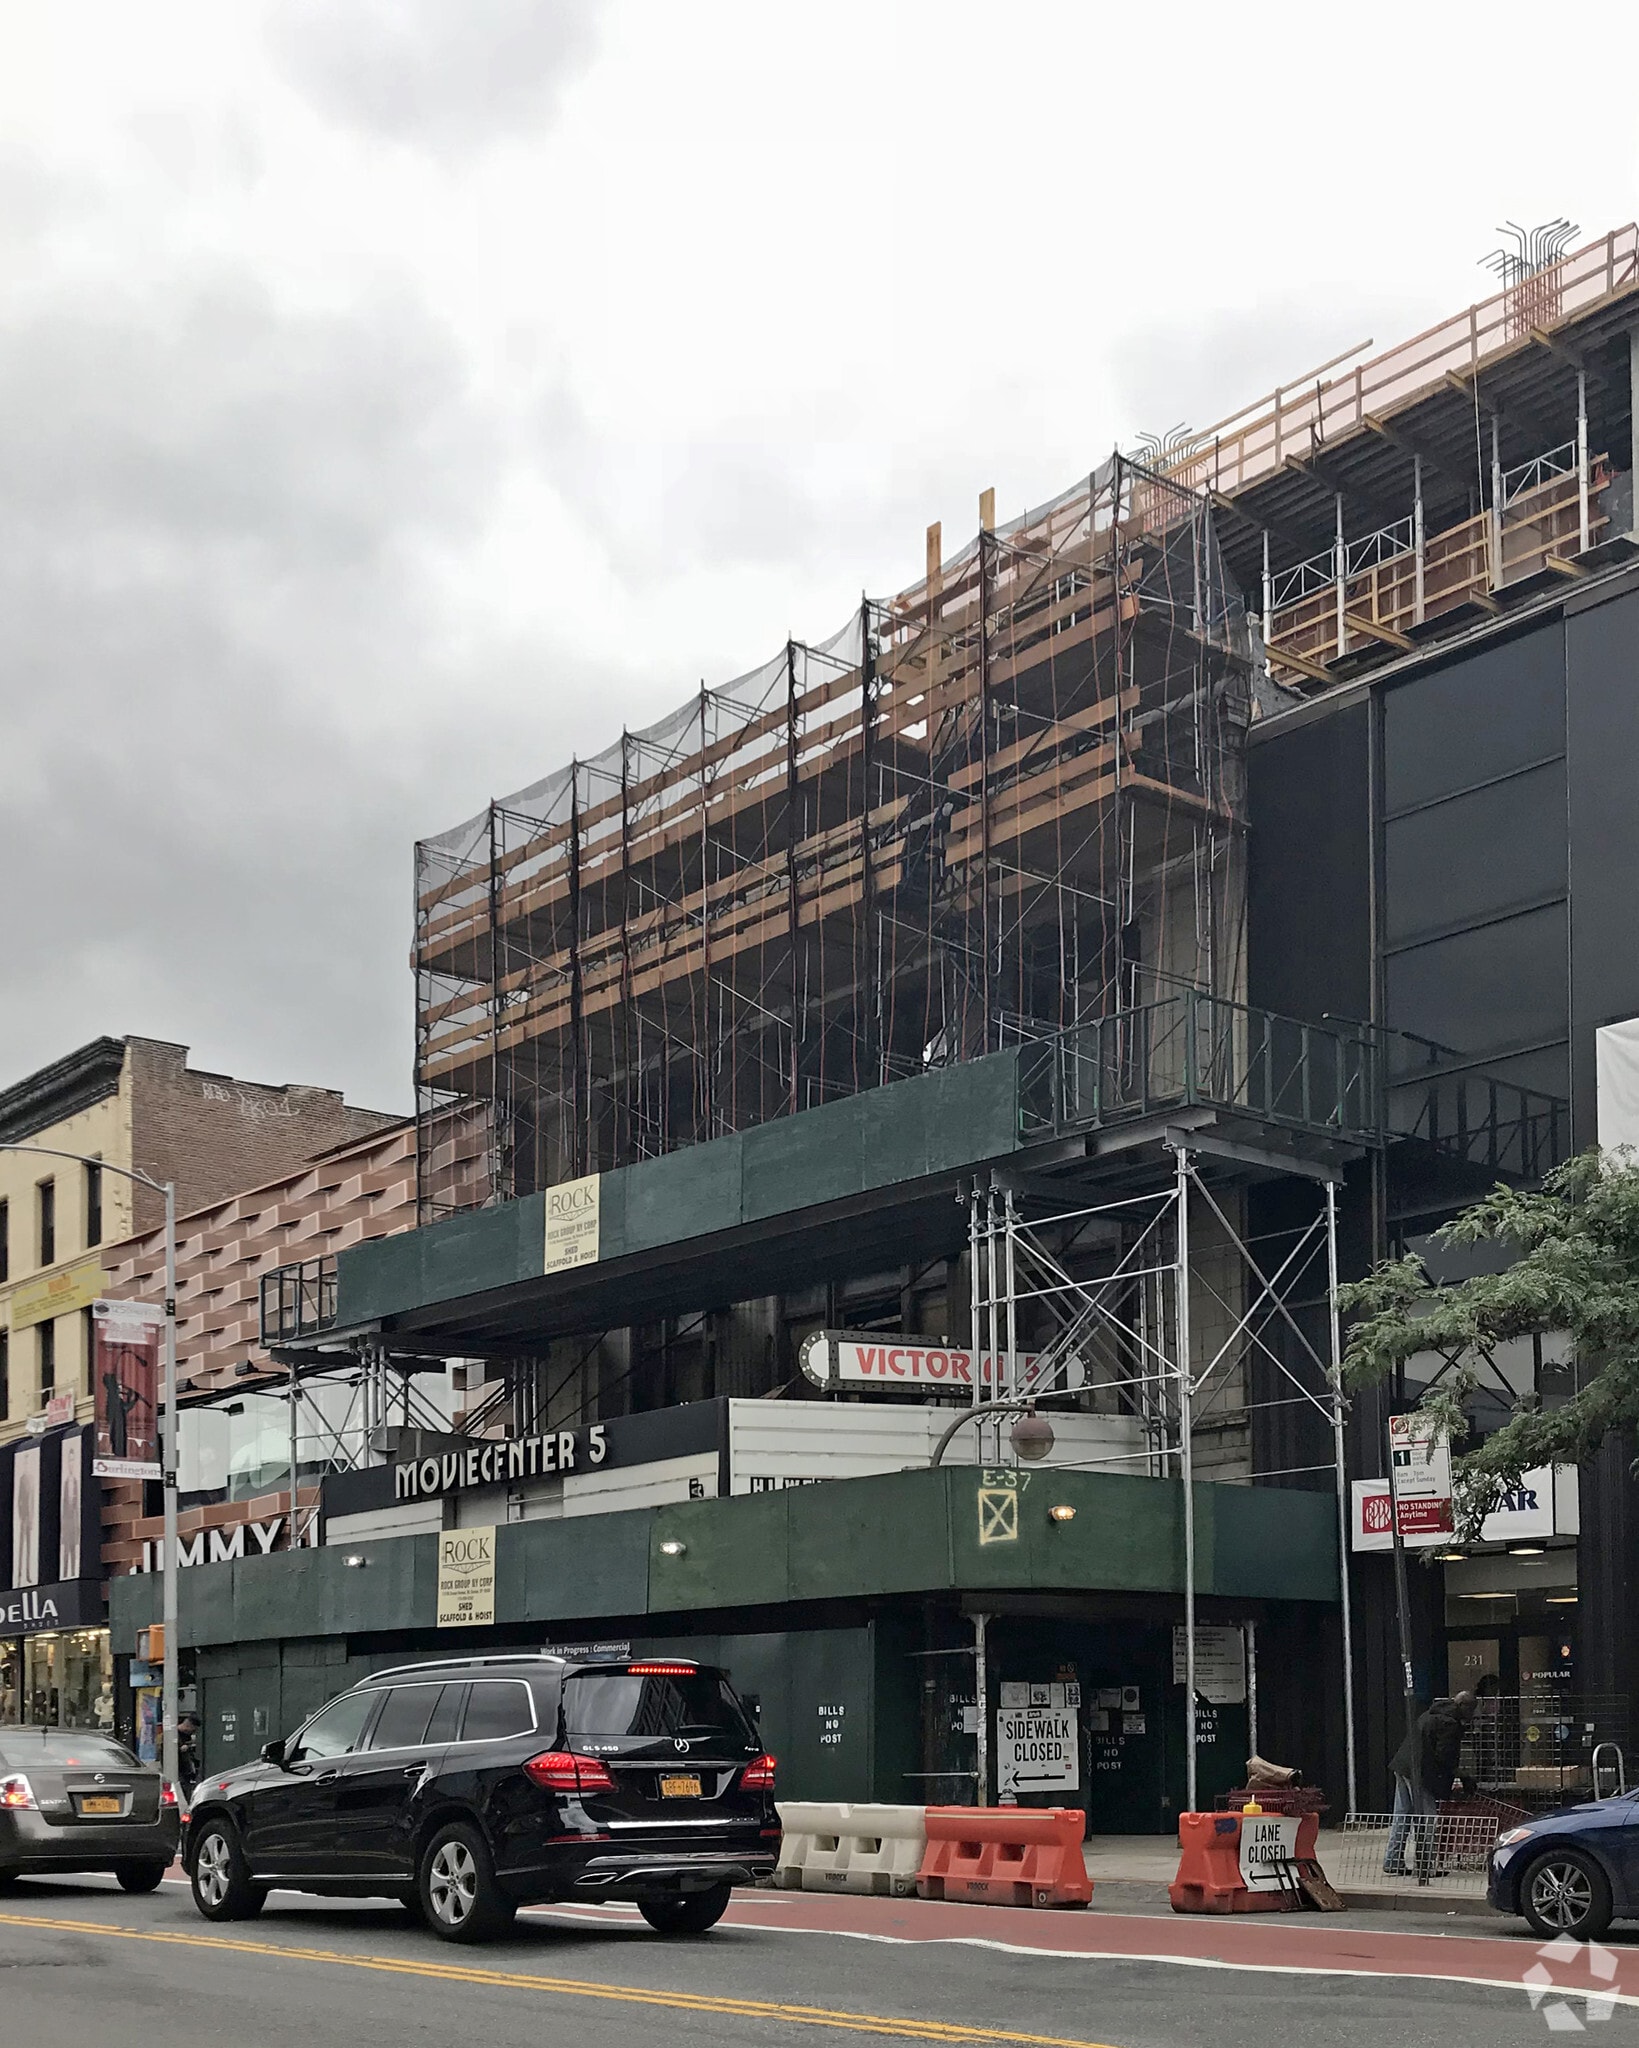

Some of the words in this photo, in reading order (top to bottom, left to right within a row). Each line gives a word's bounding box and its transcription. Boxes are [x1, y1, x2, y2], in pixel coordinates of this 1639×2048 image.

[551, 1184, 595, 1216] ROCK
[564, 1245, 578, 1256] SHED
[546, 1255, 572, 1270] SCAFFOLD
[573, 1254, 579, 1263] &
[580, 1249, 597, 1261] HOIST
[395, 1431, 575, 1499] MOVIECENTER
[588, 1425, 606, 1464] 5
[1398, 1451, 1405, 1465] 1
[982, 1469, 1032, 1492] E-37
[1399, 1503, 1410, 1511] NO
[1411, 1501, 1443, 1510] STANDIN
[1400, 1511, 1428, 1521] Anytime
[444, 1537, 491, 1564] ROCK
[441, 1581, 453, 1591] ROCK
[454, 1579, 471, 1590] GROUP
[480, 1577, 493, 1588] CORP
[458, 1602, 473, 1612] SHED
[440, 1613, 467, 1623] SCAFFOLD
[468, 1612, 473, 1621] &
[475, 1611, 493, 1621] HOIST
[540, 1646, 556, 1656] Work
[557, 1645, 563, 1655] in
[564, 1644, 589, 1656] Progress
[593, 1641, 631, 1653] Commercial
[1464, 1655, 1483, 1666] 231
[1532, 1671, 1571, 1679] POPULAR
[950, 1694, 977, 1704] BILLS
[818, 1706, 845, 1716] BILLS
[825, 1720, 839, 1730] NO
[951, 1721, 964, 1731] PO
[1005, 1719, 1070, 1740] SIDEWALK
[1201, 1721, 1213, 1731] NO
[820, 1733, 842, 1743] POST
[1096, 1736, 1126, 1746] BILLS
[1195, 1734, 1217, 1743] POST
[1014, 1742, 1062, 1762] CLOSED
[1103, 1749, 1119, 1757] NO
[1096, 1761, 1122, 1770] POST
[1255, 1824, 1281, 1842] LANE
[1248, 1844, 1286, 1864] CLOSED
